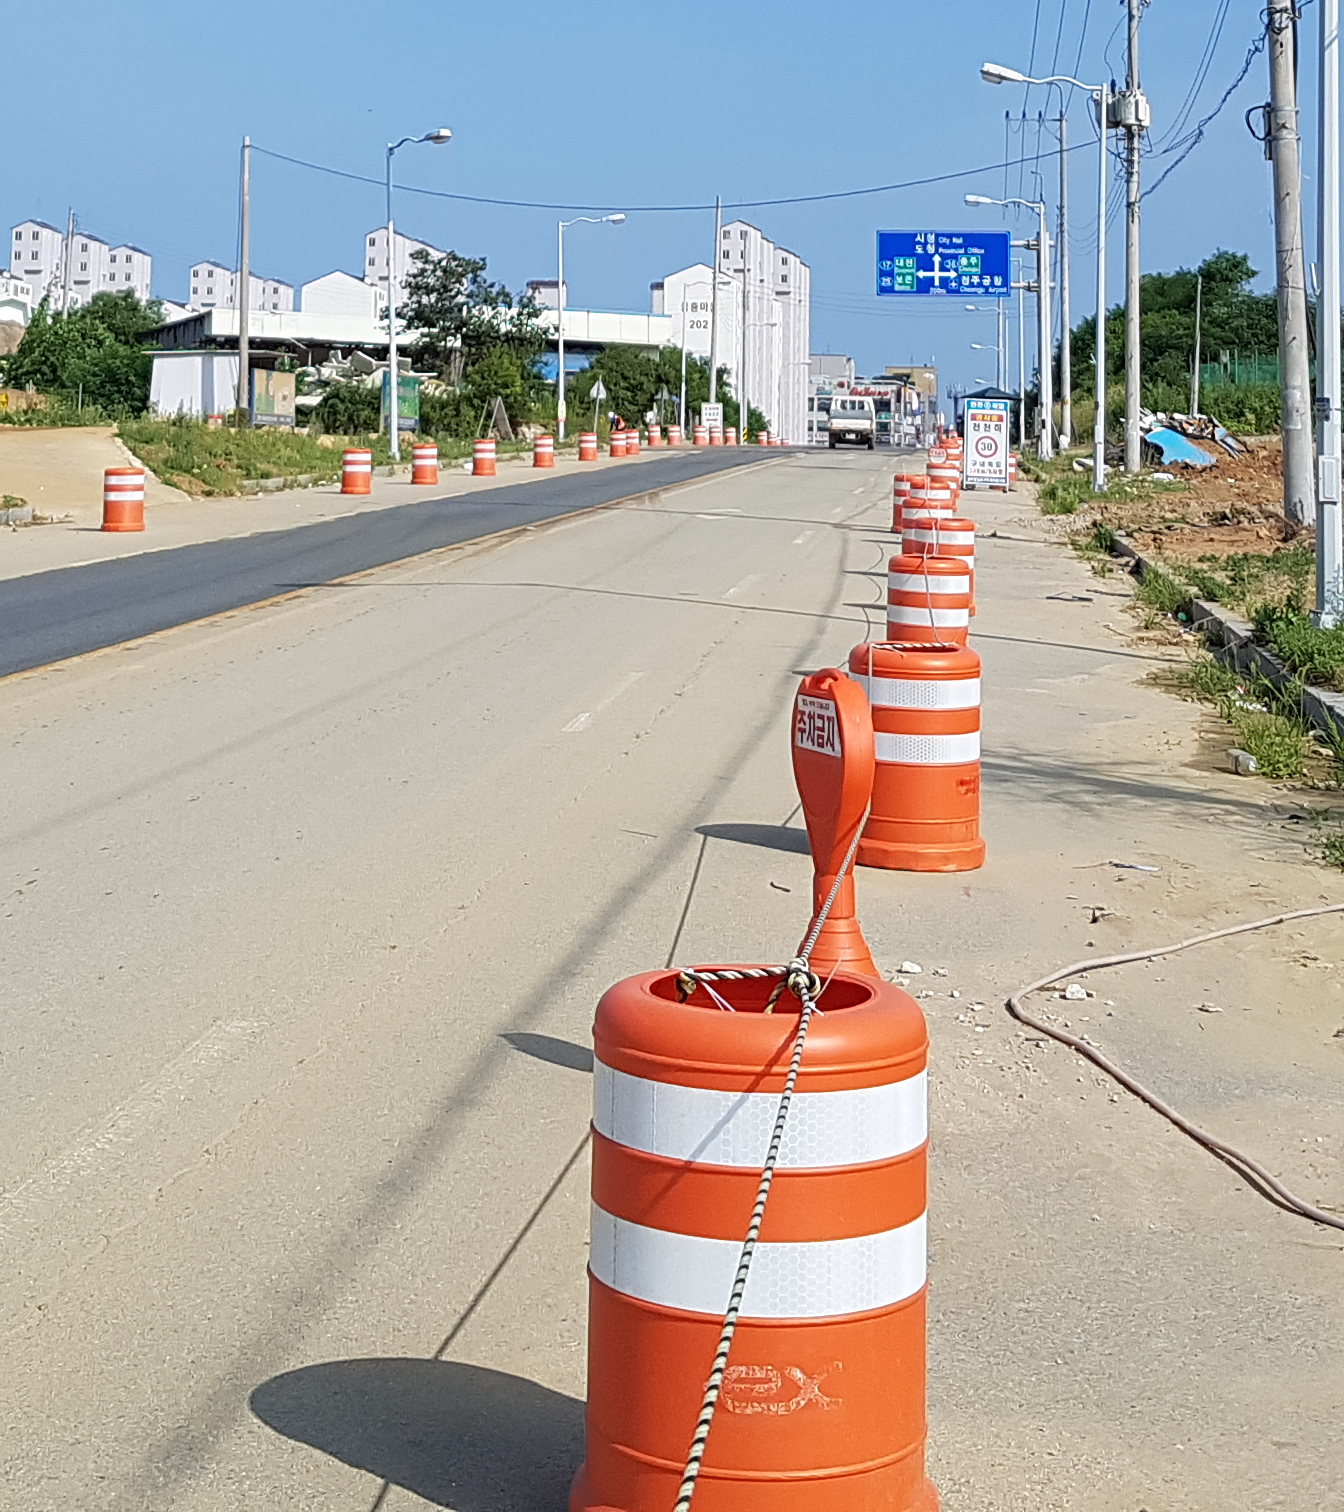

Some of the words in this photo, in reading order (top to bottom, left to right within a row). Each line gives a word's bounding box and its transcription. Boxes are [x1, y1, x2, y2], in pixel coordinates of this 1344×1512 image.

[689, 319, 709, 330] 202
[980, 441, 993, 451] 30
[797, 709, 836, 752] 주차금지
